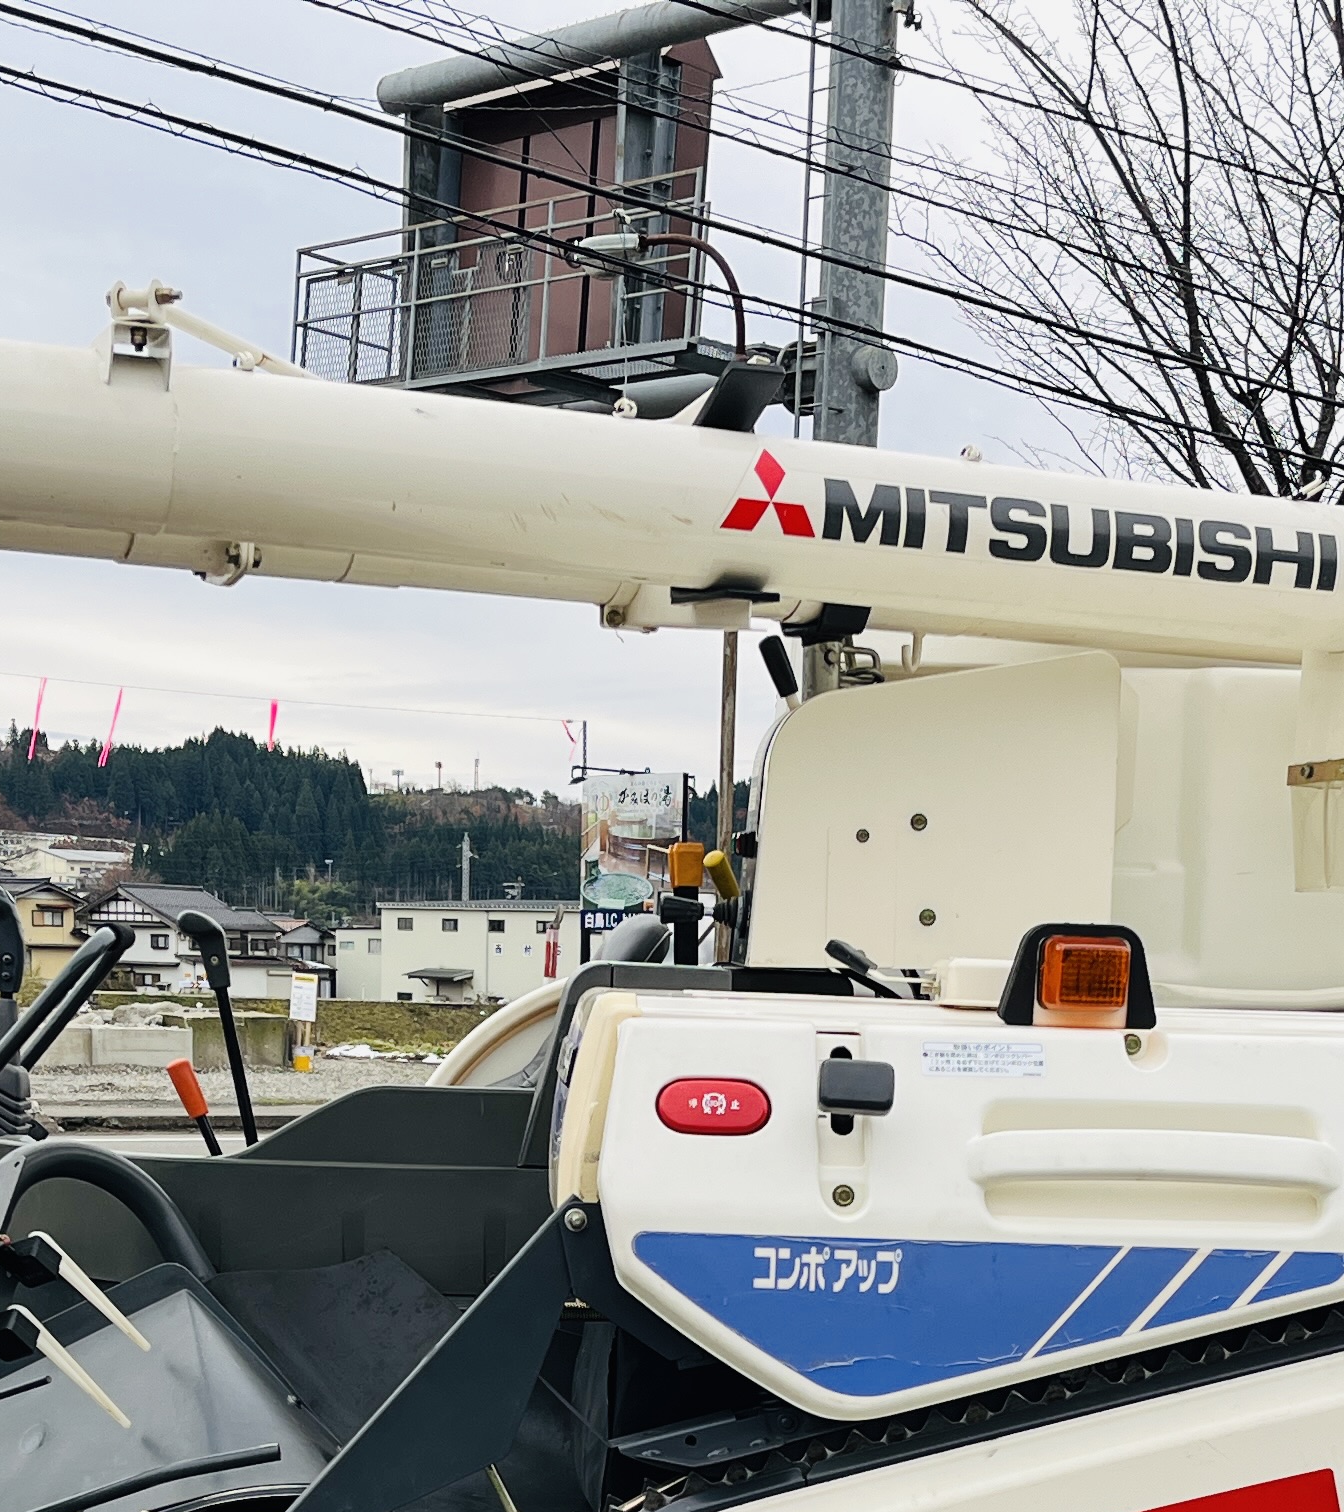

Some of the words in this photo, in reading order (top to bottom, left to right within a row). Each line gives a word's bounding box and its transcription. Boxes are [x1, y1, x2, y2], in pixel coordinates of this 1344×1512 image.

[821, 478, 1338, 592] MITSUBISHI
[752, 1246, 903, 1294] コンポアップ
